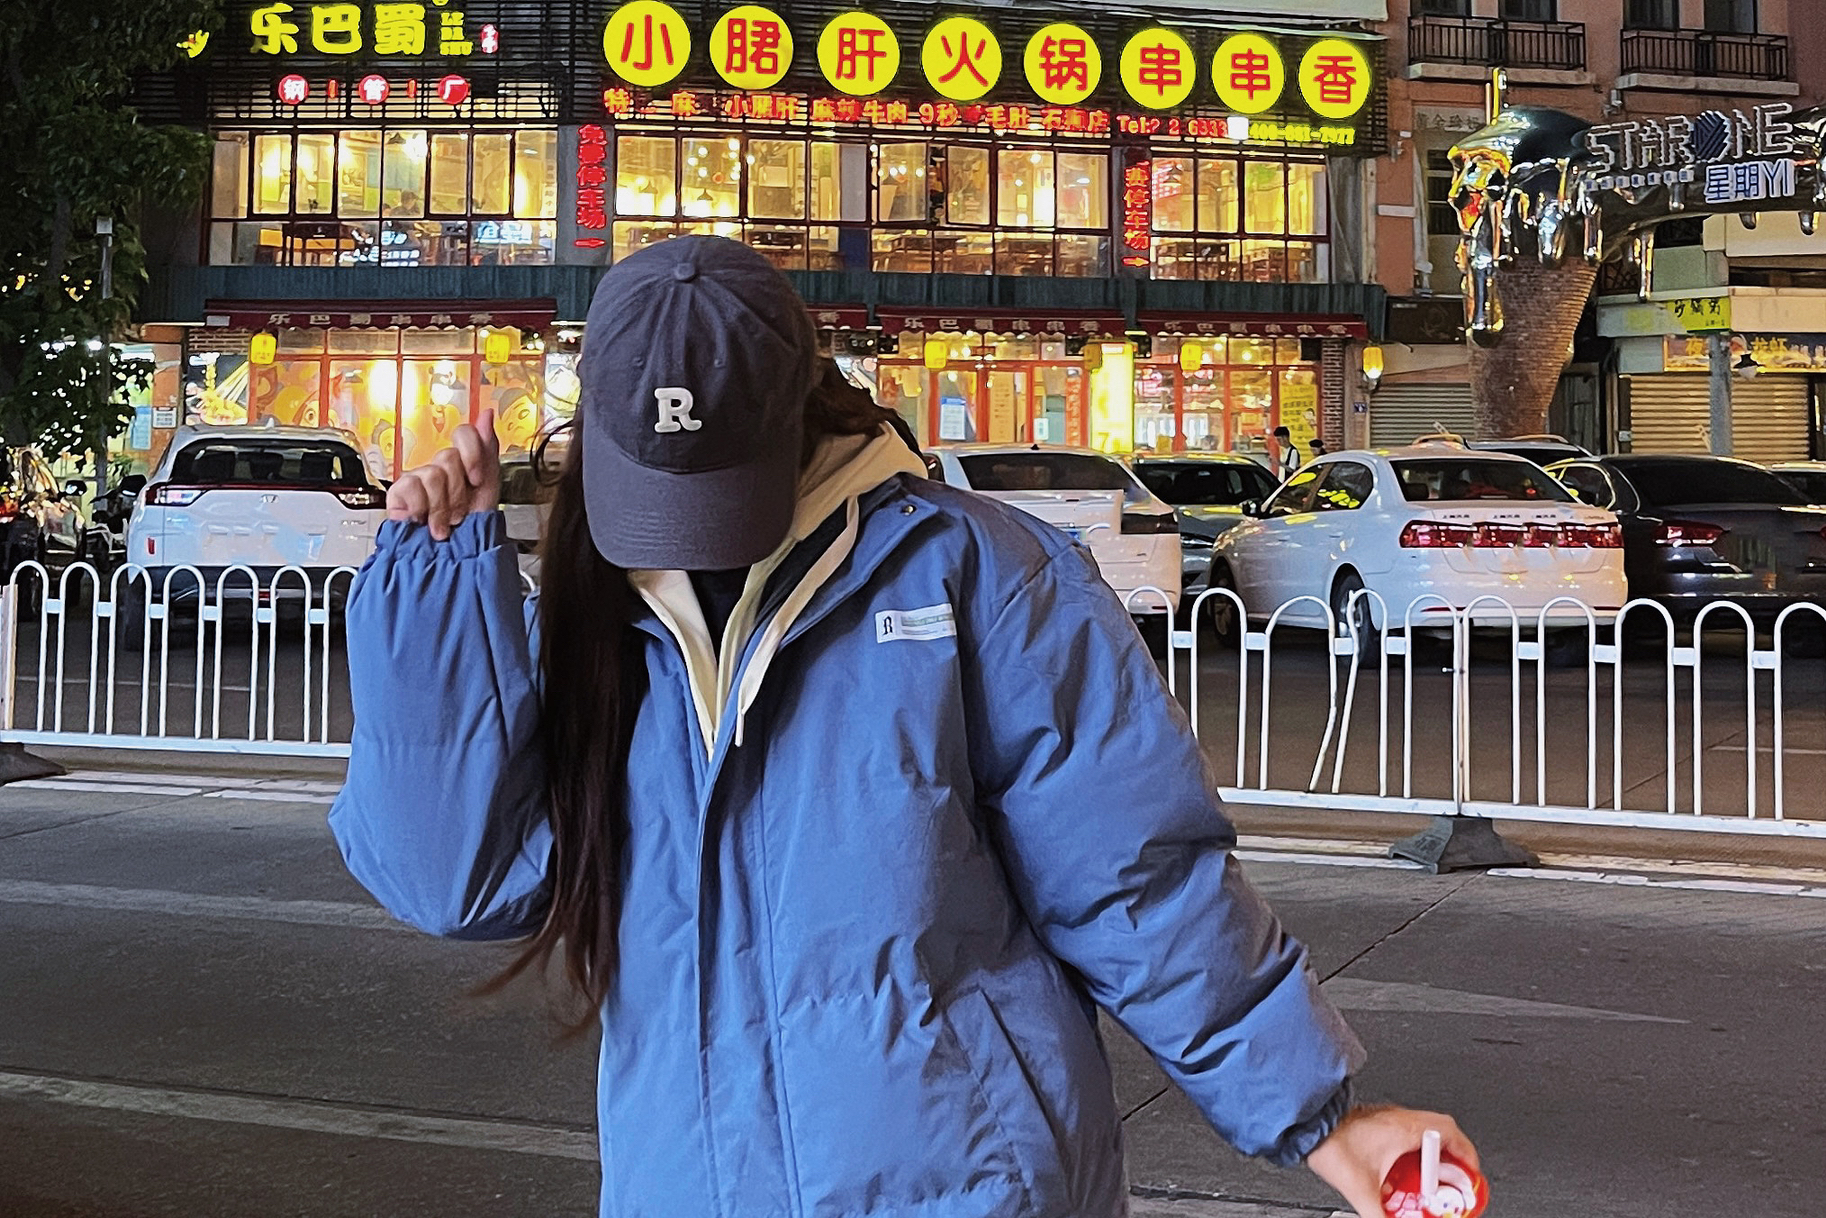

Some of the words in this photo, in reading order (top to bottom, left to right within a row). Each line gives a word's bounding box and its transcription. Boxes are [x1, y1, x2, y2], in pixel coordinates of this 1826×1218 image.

[250, 3, 426, 55] 乐巴蜀
[919, 103, 1030, 129] 9秒毛肚
[1124, 161, 1149, 249] 费停车场
[654, 387, 702, 433] R
